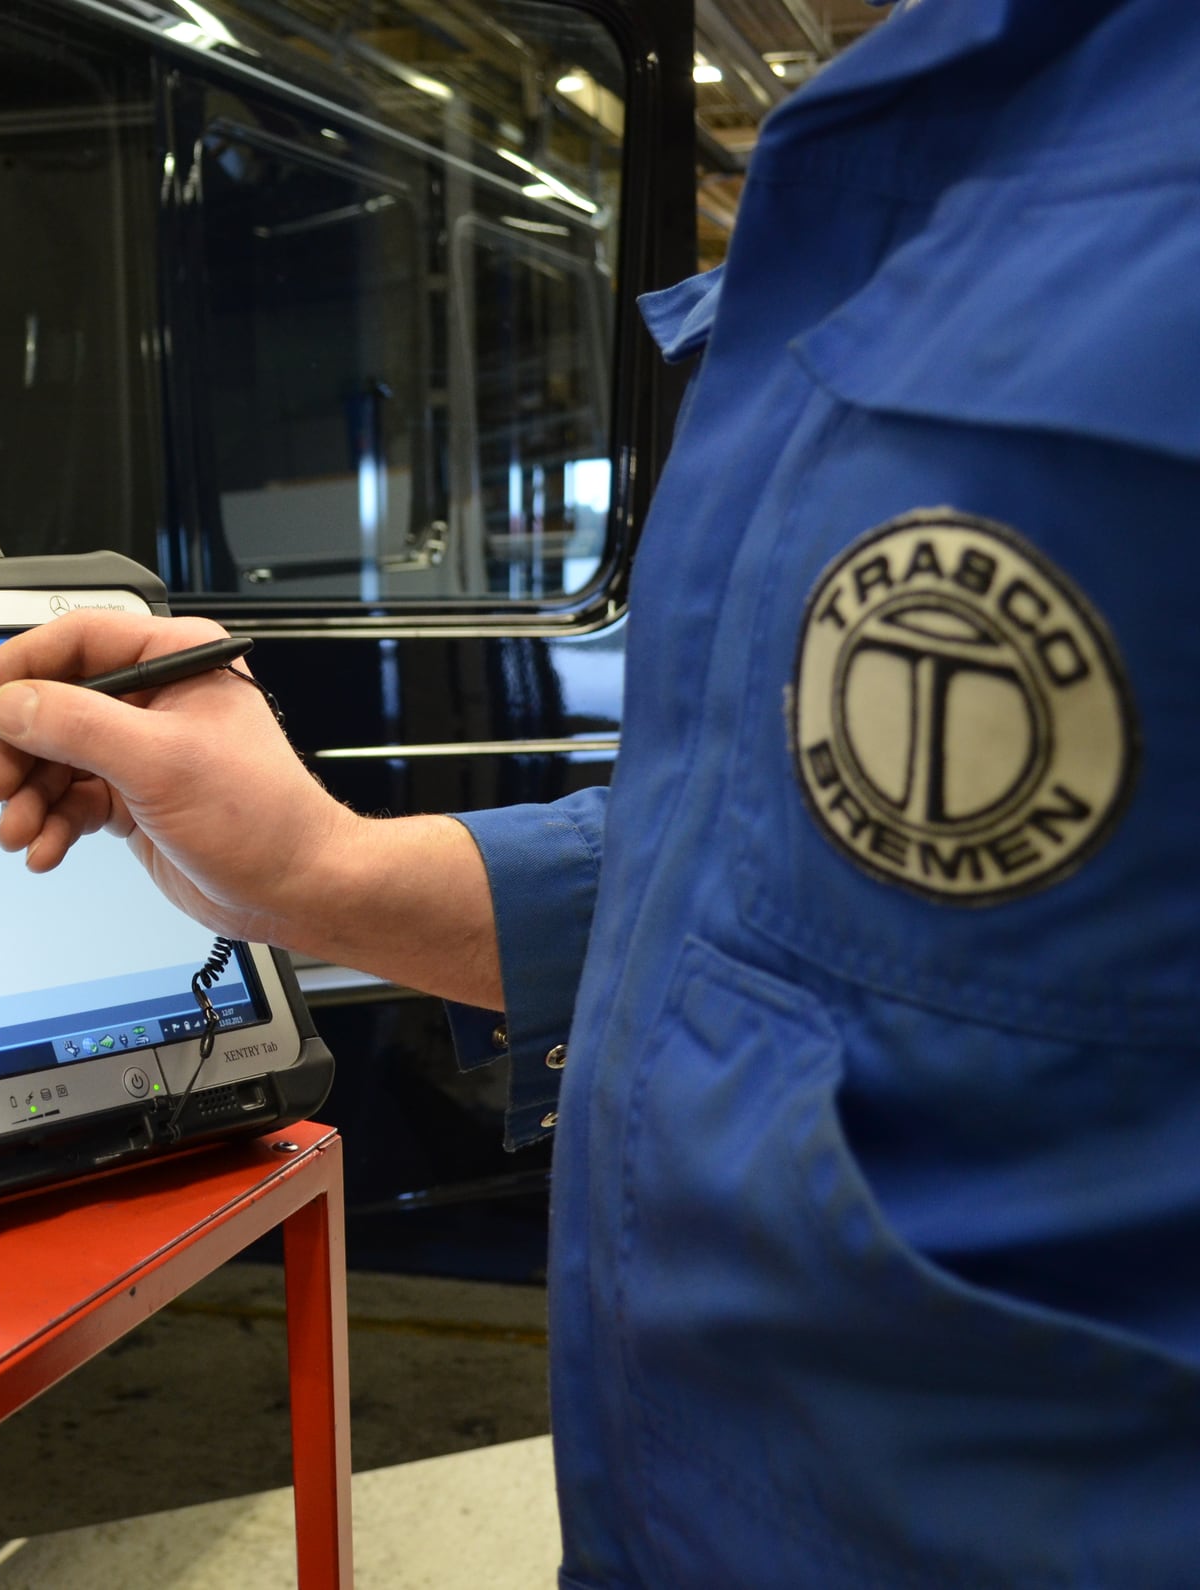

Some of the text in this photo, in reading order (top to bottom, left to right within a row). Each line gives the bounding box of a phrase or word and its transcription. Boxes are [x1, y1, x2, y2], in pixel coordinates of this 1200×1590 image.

[818, 542, 1091, 688] TRASCO
[807, 740, 1093, 882] BREMEN
[224, 1041, 278, 1063] XENTRY Tab
